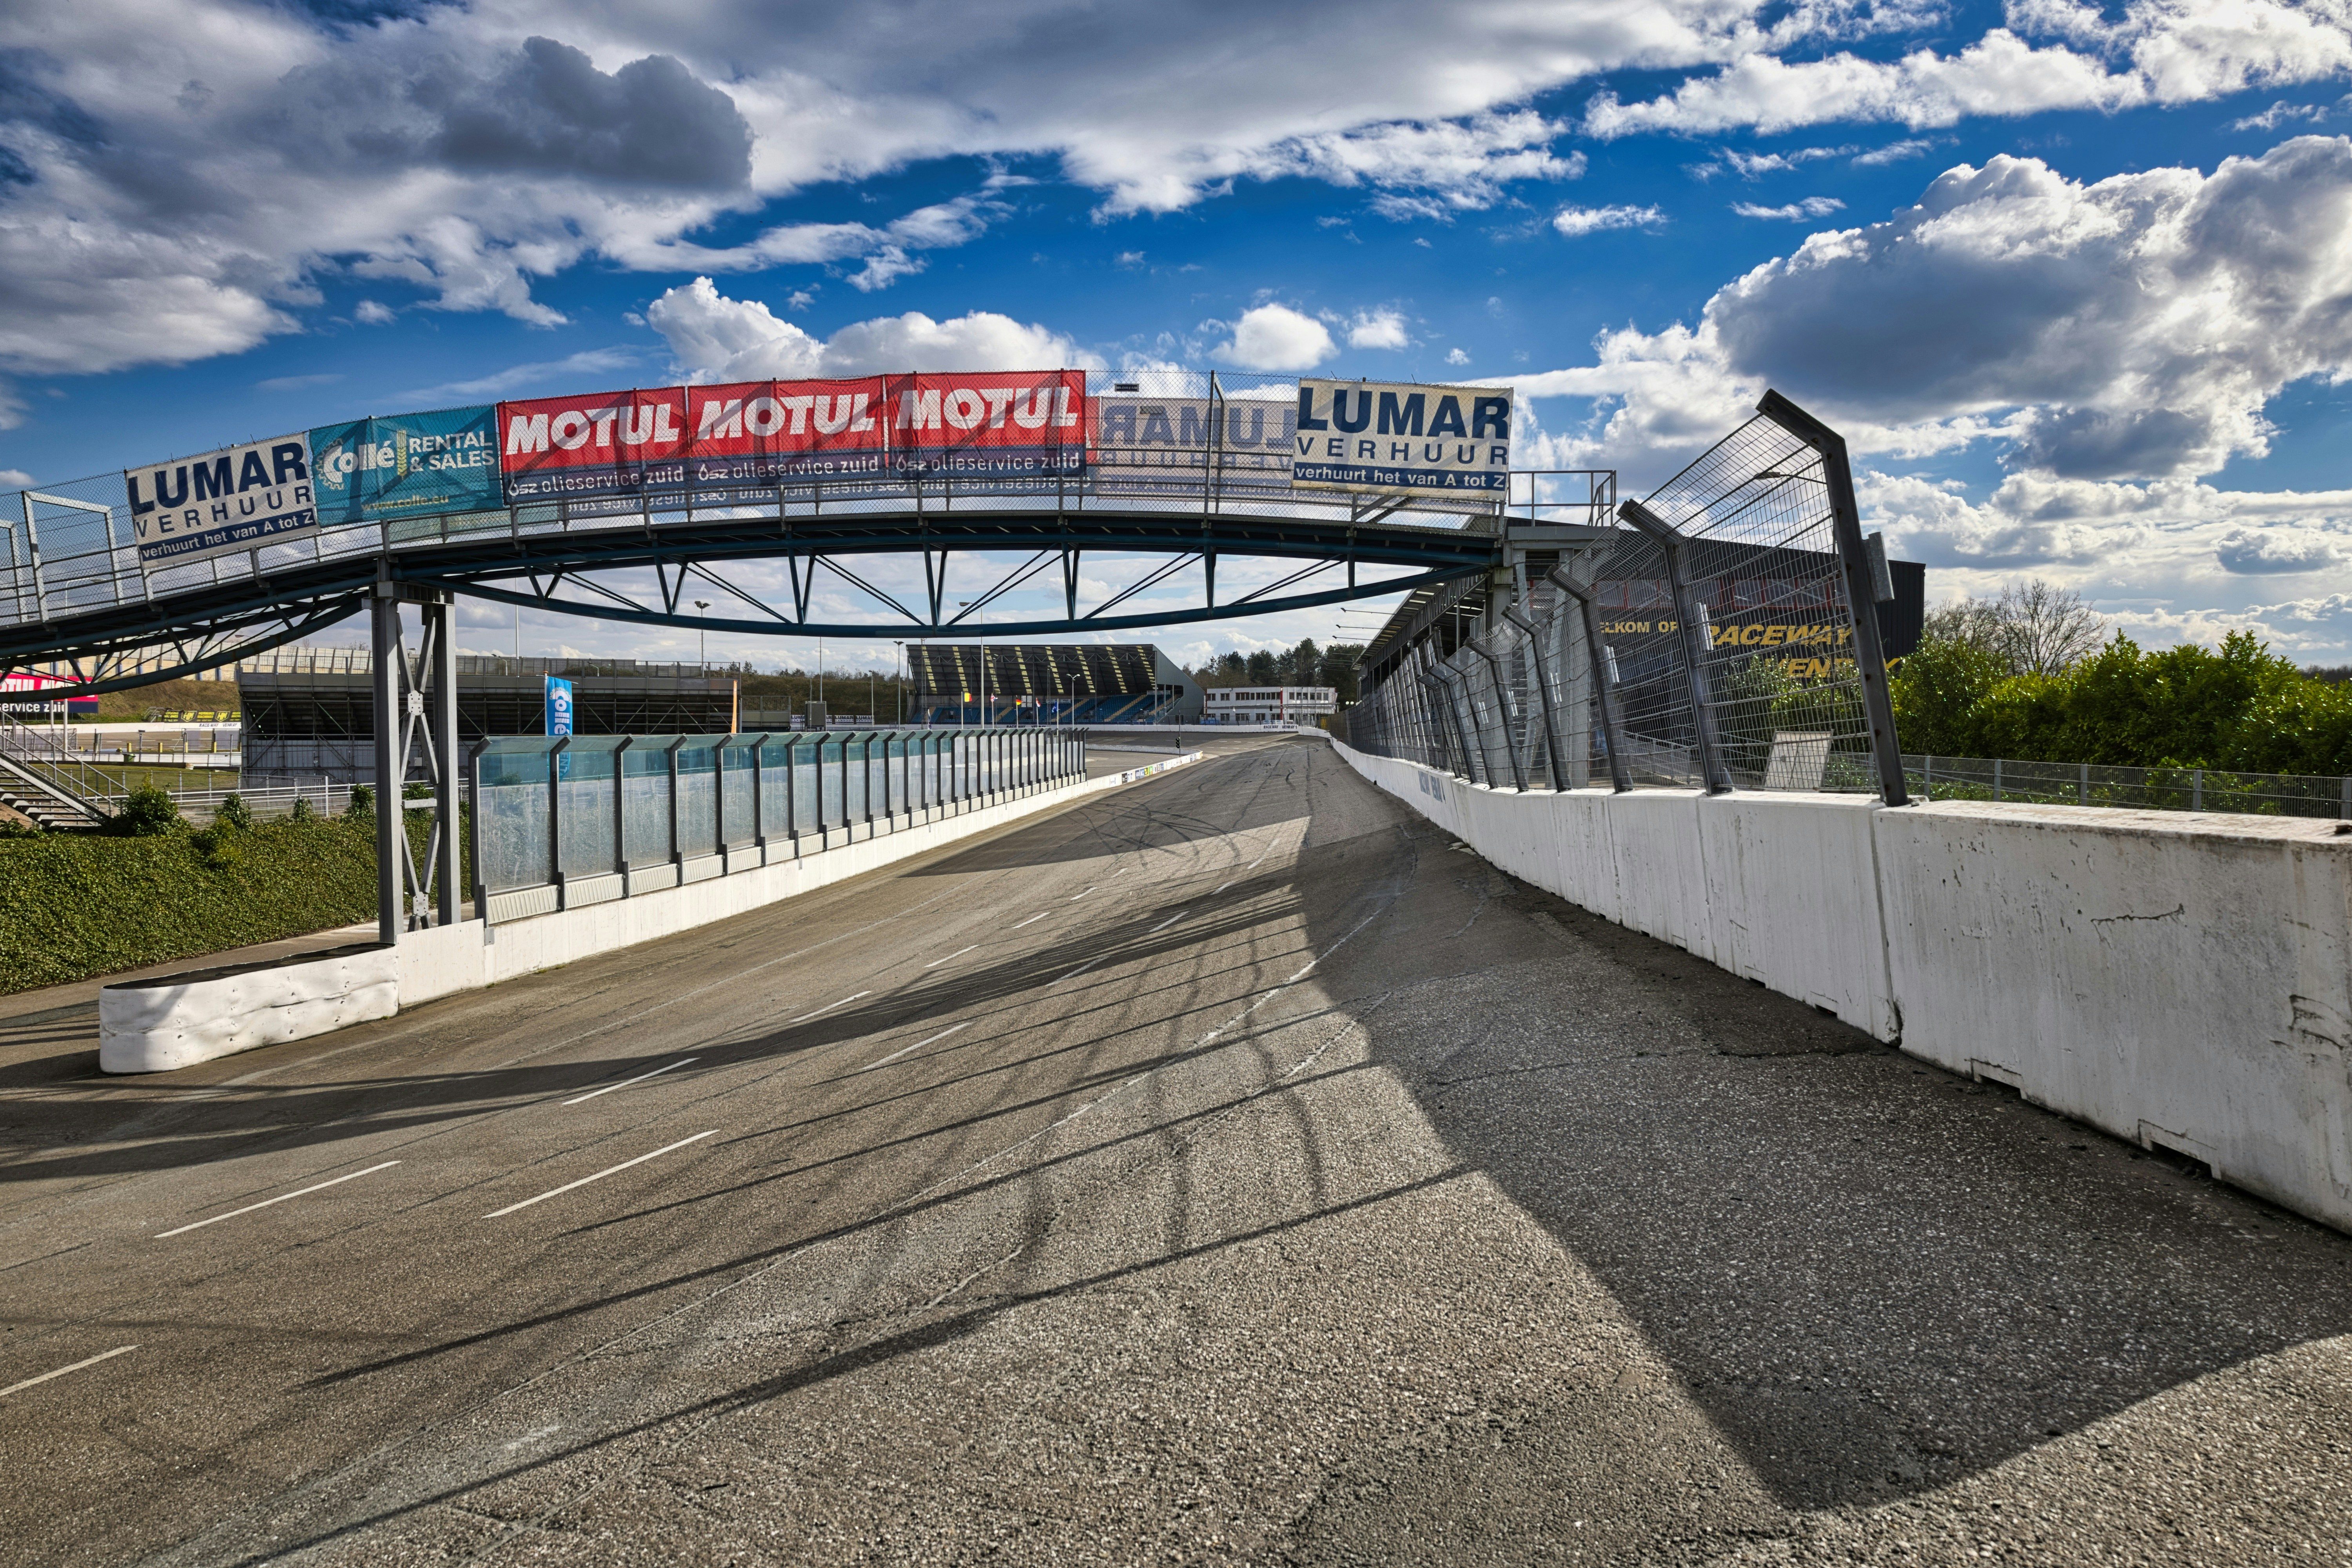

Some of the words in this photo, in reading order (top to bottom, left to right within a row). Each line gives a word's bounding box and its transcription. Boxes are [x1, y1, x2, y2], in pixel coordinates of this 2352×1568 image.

[697, 393, 876, 440] MOTUL
[896, 386, 1078, 430] MOTUL
[1299, 387, 1510, 439] LUMAR
[506, 403, 679, 456] MOTUL
[321, 438, 395, 485] Collé
[409, 430, 493, 454] RENTAL
[409, 456, 424, 472] &
[429, 450, 495, 470] SALES
[931, 454, 1034, 471] olieservice
[1041, 452, 1079, 469] zuid
[1296, 436, 1508, 466] VERHUUR
[128, 442, 308, 516] LUMAR
[542, 471, 640, 493] olieservice
[646, 466, 684, 484] zuid
[733, 459, 833, 478] olieservice
[840, 456, 878, 473] zuid
[1296, 466, 1367, 481] verhuurt
[1374, 468, 1402, 484] het
[1408, 473, 1437, 485] van
[1444, 473, 1457, 486] A
[1463, 474, 1487, 487] tot
[1494, 475, 1505, 488] Z
[136, 486, 310, 538] VERHUUR
[361, 495, 449, 512] www.colle.eu
[143, 537, 199, 558] verhuurt
[204, 529, 228, 544] het
[232, 526, 258, 539] van
[263, 521, 274, 532] A
[278, 517, 299, 530] tot
[303, 512, 313, 524] Z
[1599, 621, 1650, 633] ELKOM
[0, 702, 40, 712] ervice
